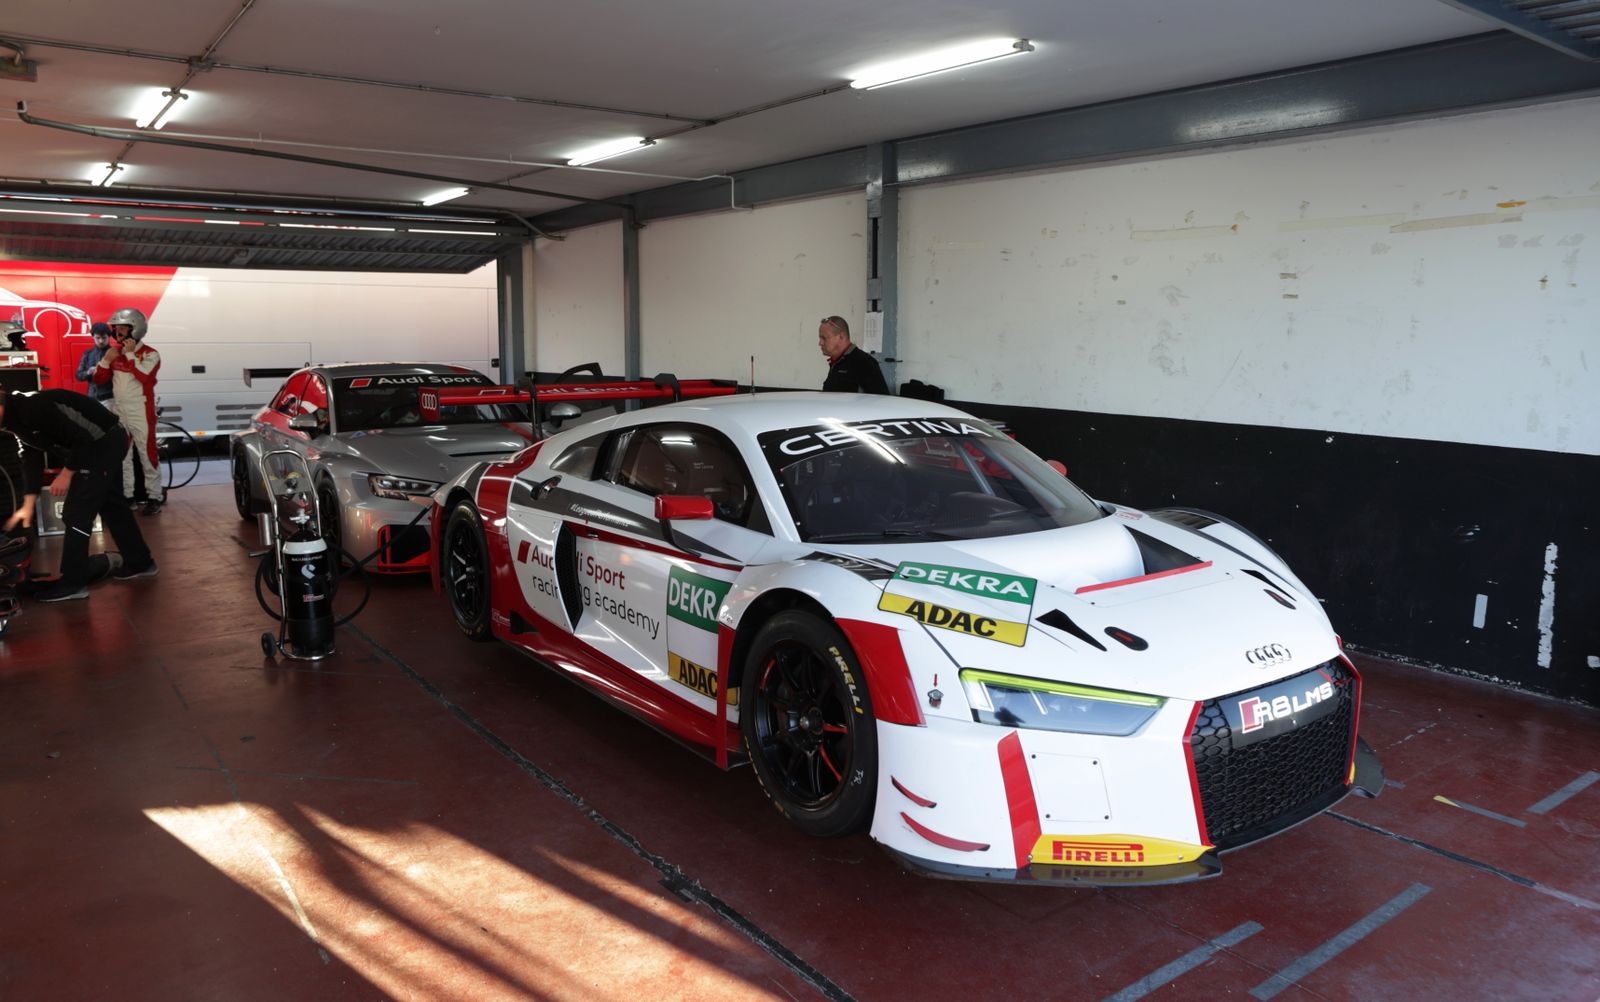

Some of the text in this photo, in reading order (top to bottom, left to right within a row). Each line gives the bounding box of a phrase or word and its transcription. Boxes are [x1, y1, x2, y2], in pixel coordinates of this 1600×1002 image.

[377, 375, 483, 387] Audi Sport
[779, 420, 993, 456] CERTINA
[586, 555, 626, 590] Sport
[900, 566, 1029, 598] DEKRA
[594, 590, 660, 640] academy
[669, 577, 716, 621] DEKR
[905, 600, 998, 638] ADAC
[679, 658, 718, 699] ADAC
[1052, 840, 1145, 863] PIRELLI
